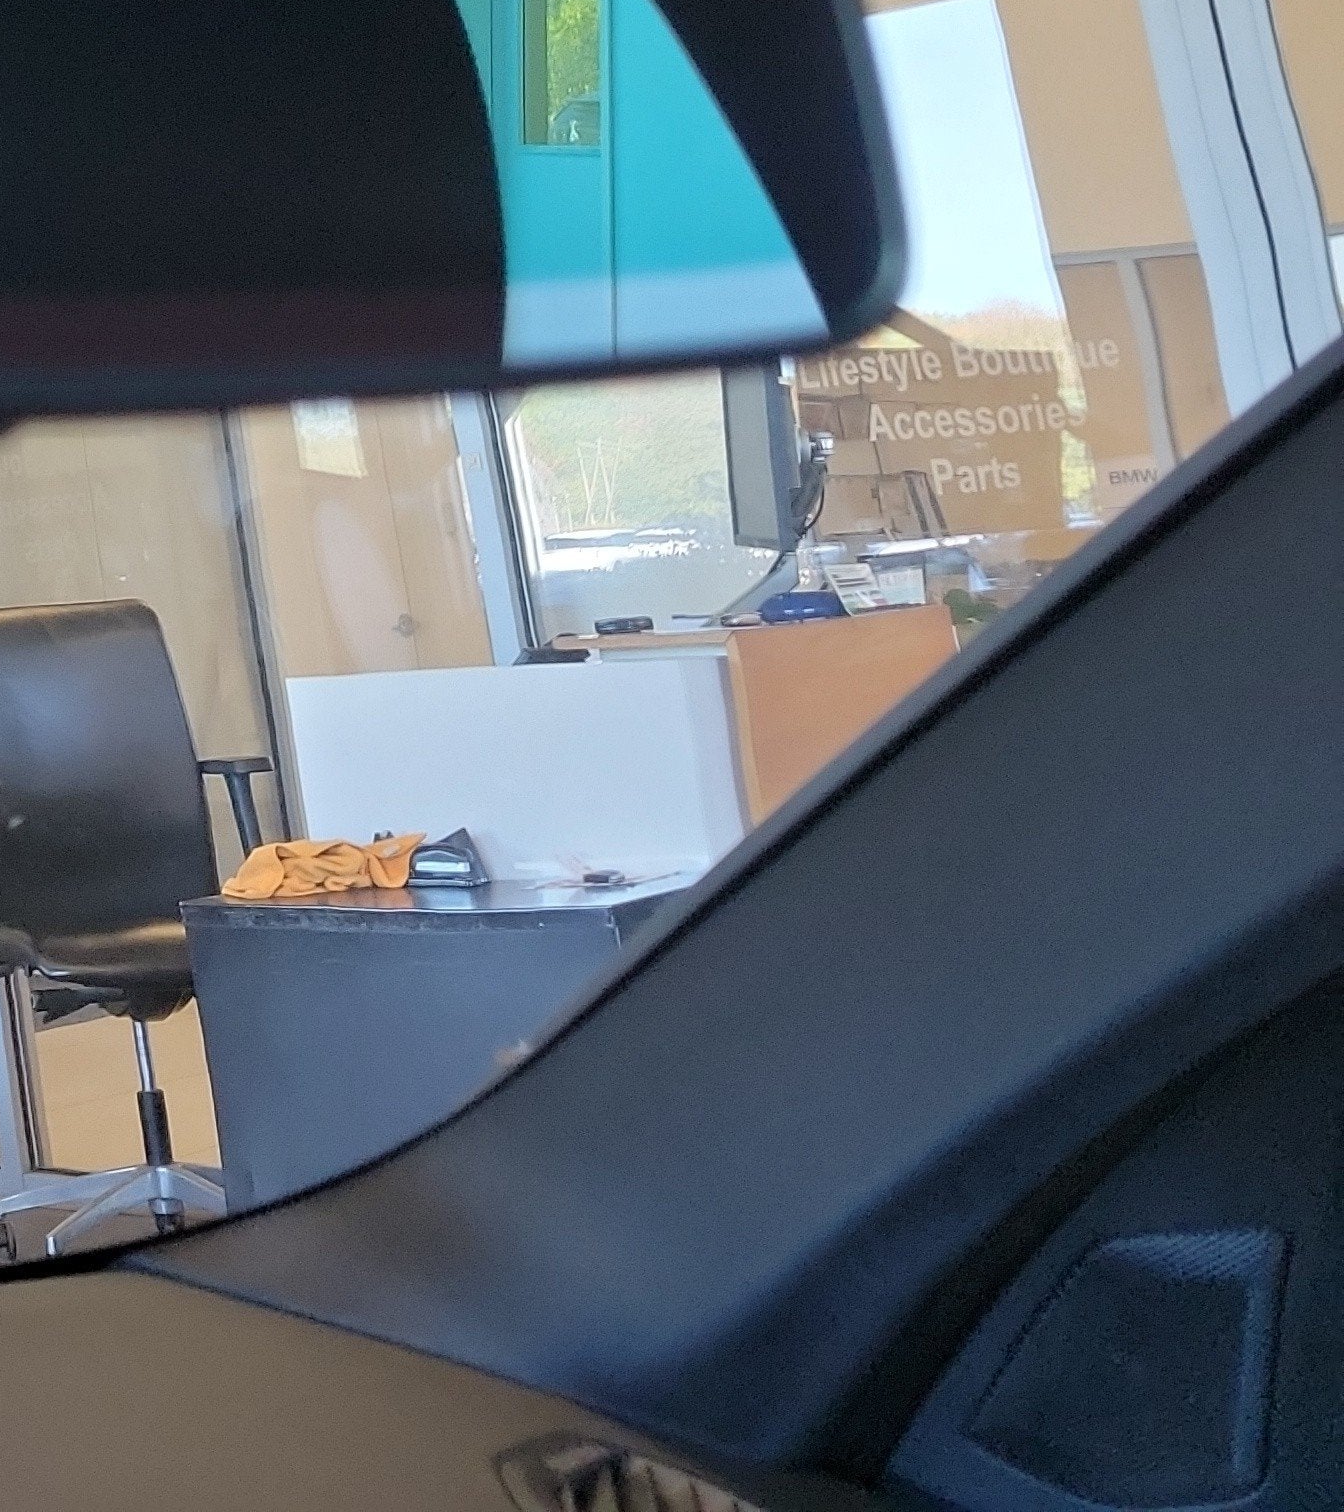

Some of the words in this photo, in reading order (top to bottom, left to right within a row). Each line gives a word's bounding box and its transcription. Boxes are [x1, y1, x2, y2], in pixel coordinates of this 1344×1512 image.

[951, 337, 1121, 380] Boutiue
[869, 393, 1089, 443] Accessories
[930, 457, 1022, 496] Parts
